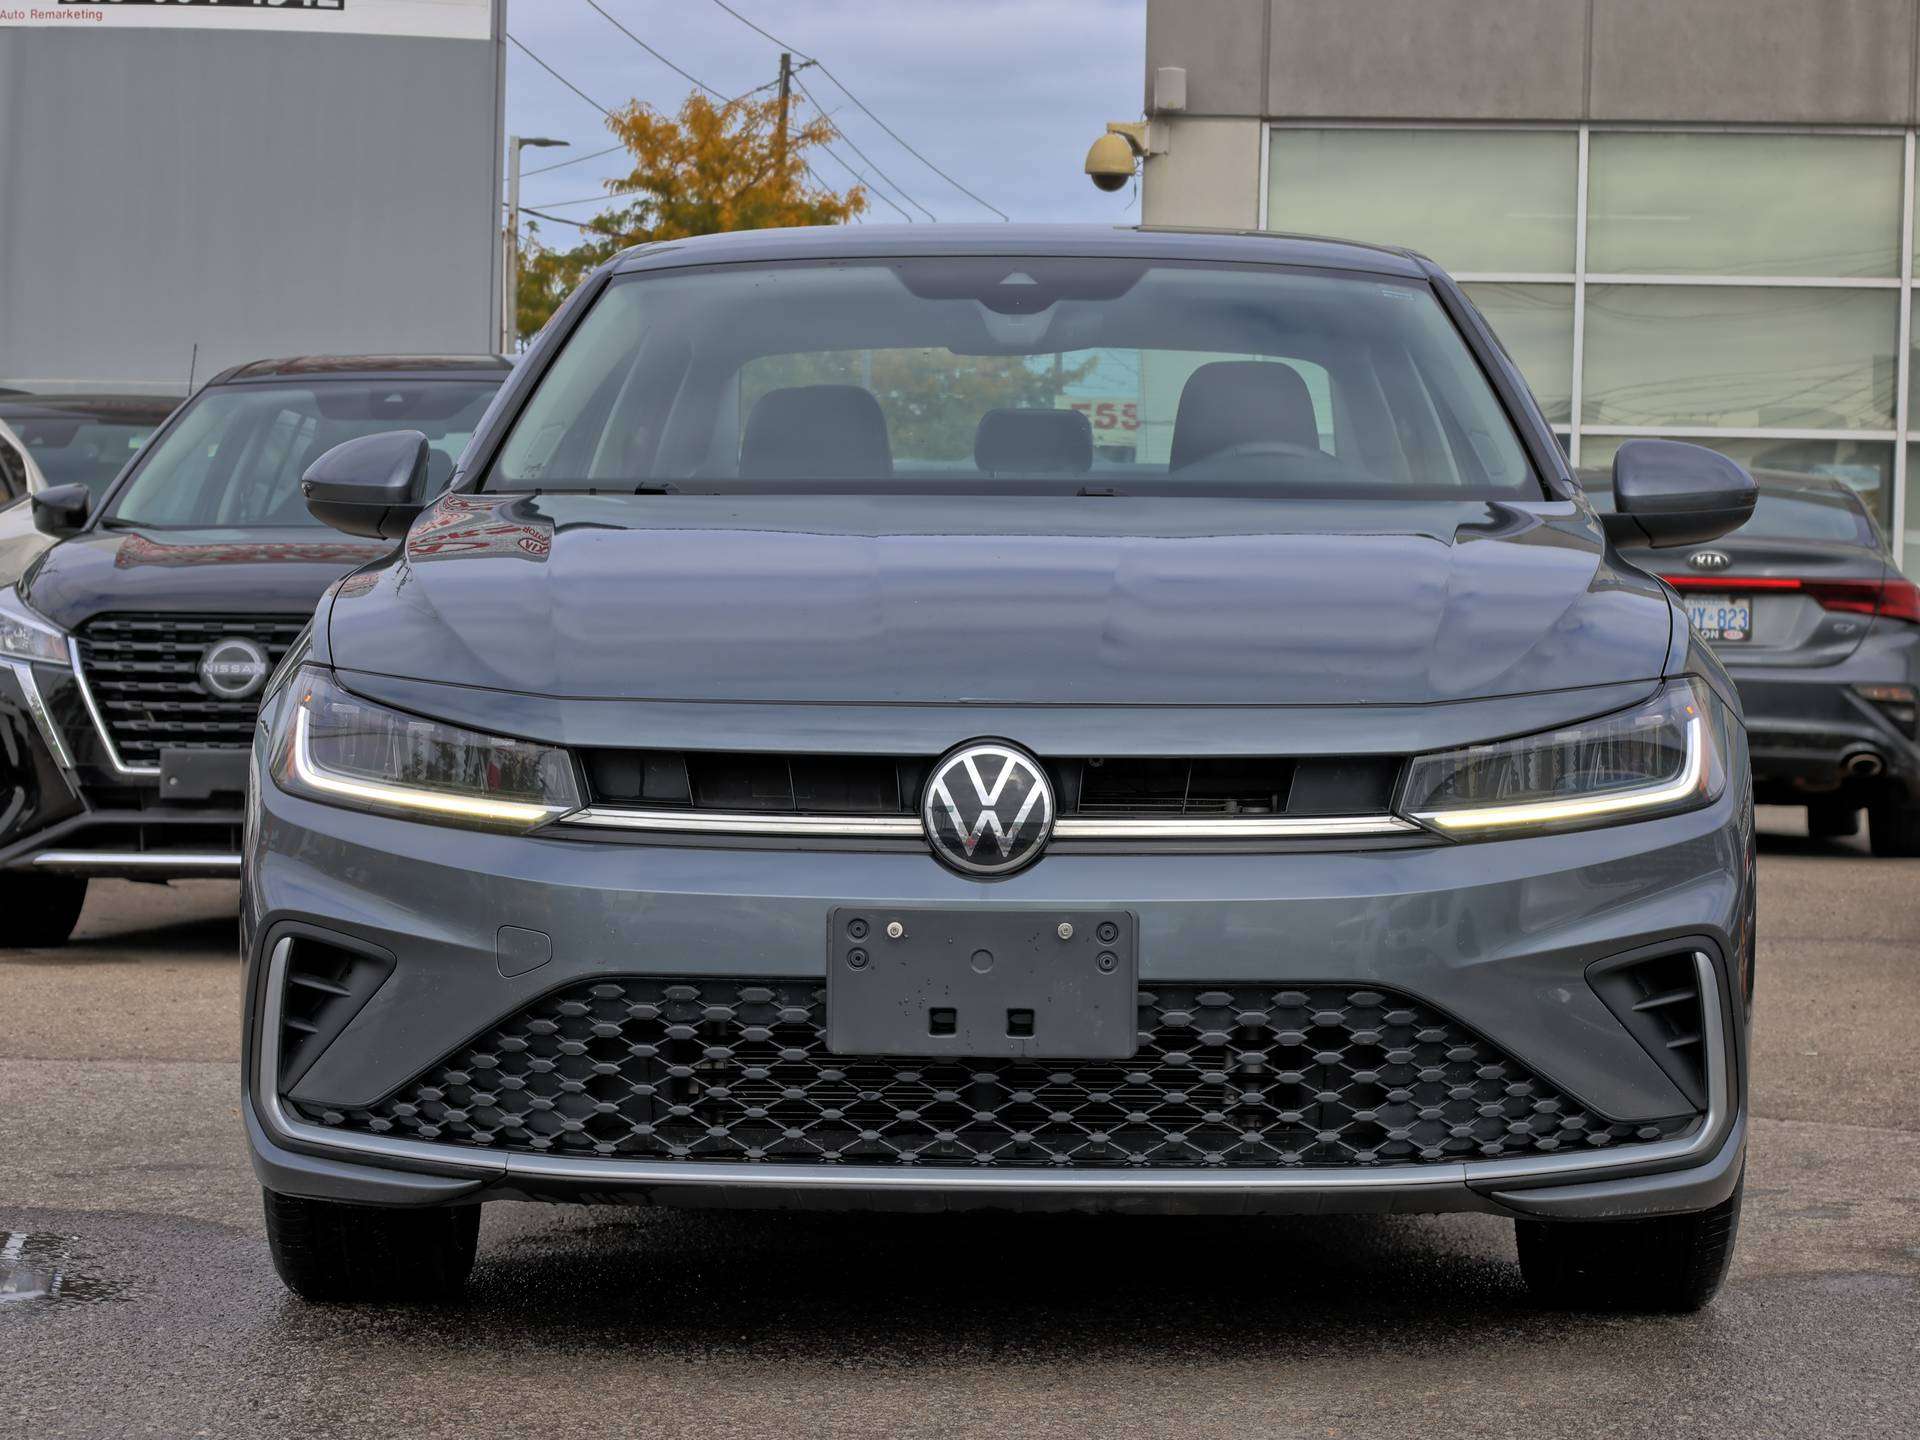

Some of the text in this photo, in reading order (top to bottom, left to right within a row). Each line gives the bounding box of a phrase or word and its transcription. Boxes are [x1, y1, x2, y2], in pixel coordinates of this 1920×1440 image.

[0, 9, 103, 21] Auto Remarketing
[1072, 403, 1141, 430] SS
[1697, 555, 1721, 567] KIA
[203, 663, 266, 673] NISSAN
[925, 745, 1052, 872] VW
